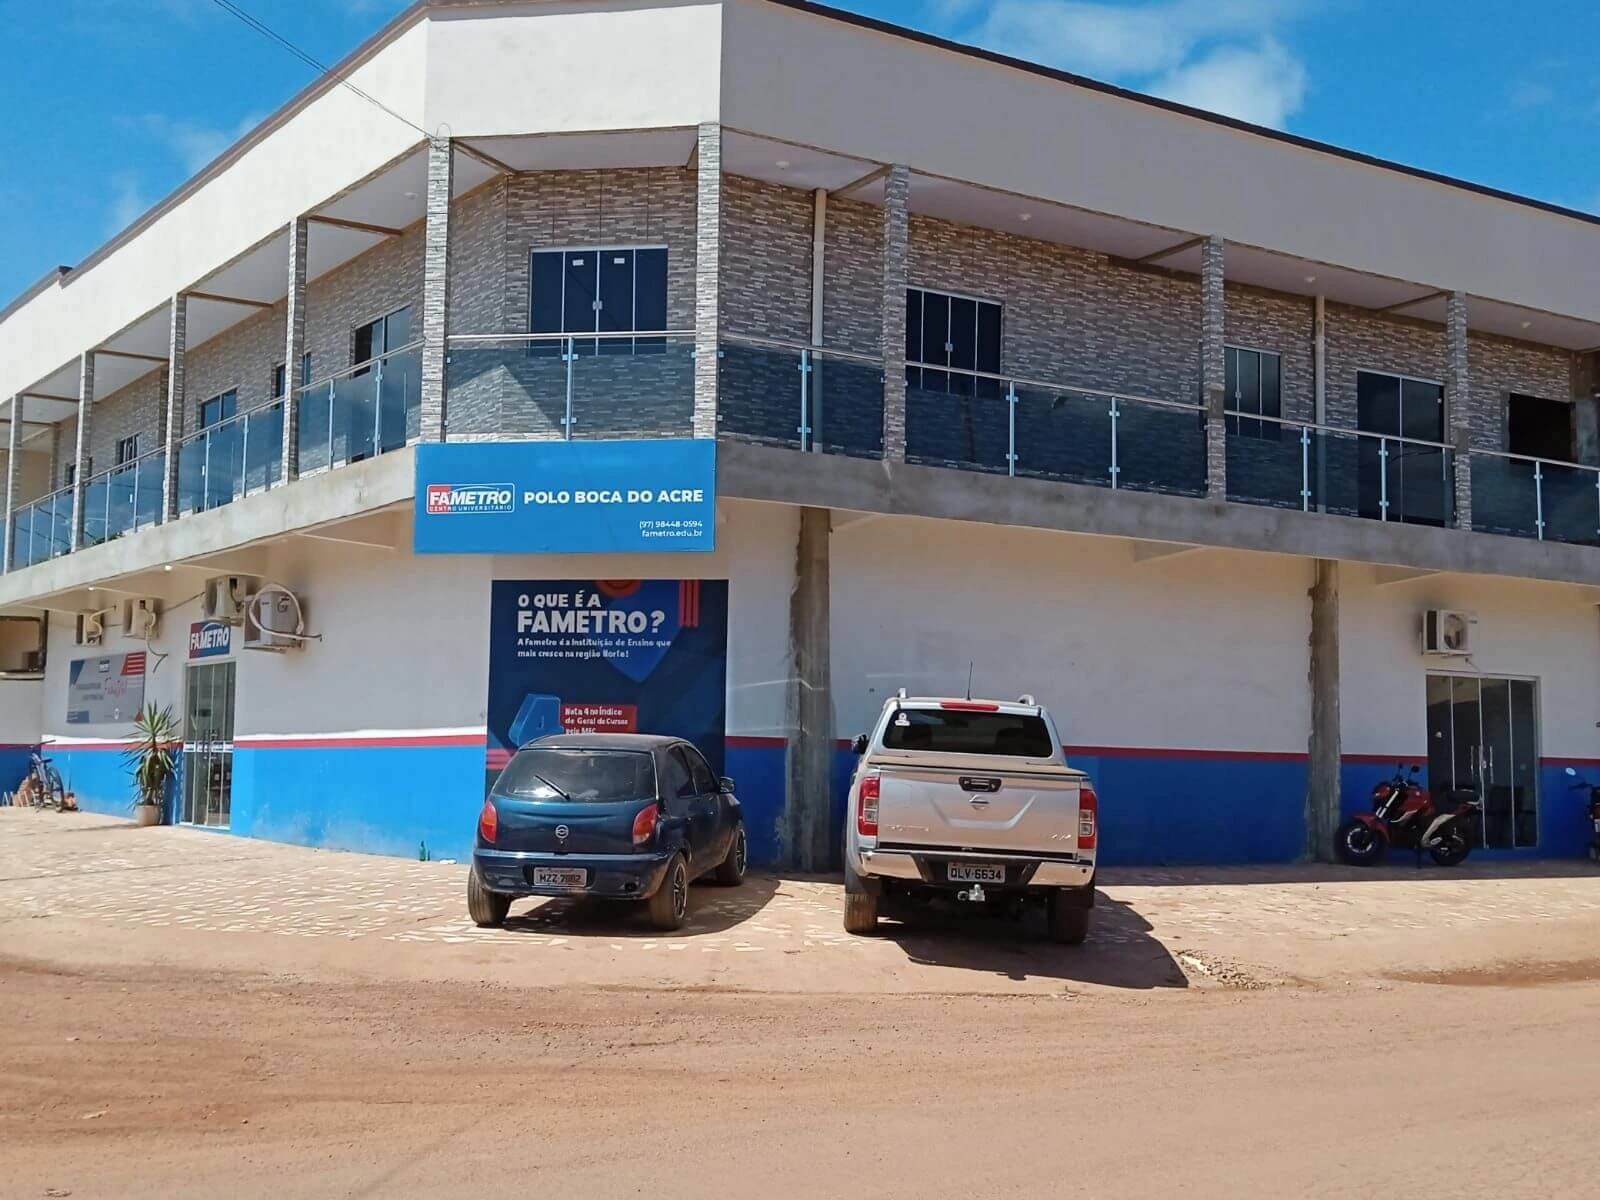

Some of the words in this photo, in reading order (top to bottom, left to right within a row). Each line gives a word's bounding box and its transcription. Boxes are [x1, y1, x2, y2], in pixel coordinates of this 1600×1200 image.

[429, 490, 512, 506] FAMETRO
[523, 491, 570, 504] POLO
[574, 491, 623, 503] BOCA
[627, 490, 653, 503] DO
[657, 489, 703, 503] ACRE
[639, 520, 654, 529] (97)
[641, 529, 702, 538] fametro.edu.br
[518, 594, 530, 607] O
[533, 594, 569, 609] QUE
[575, 590, 585, 607] É
[587, 594, 601, 607] A
[517, 610, 665, 634] FAMETRO?
[190, 626, 230, 651] FAMETRO
[517, 638, 524, 646] A
[615, 638, 626, 646] de
[656, 639, 672, 648] que
